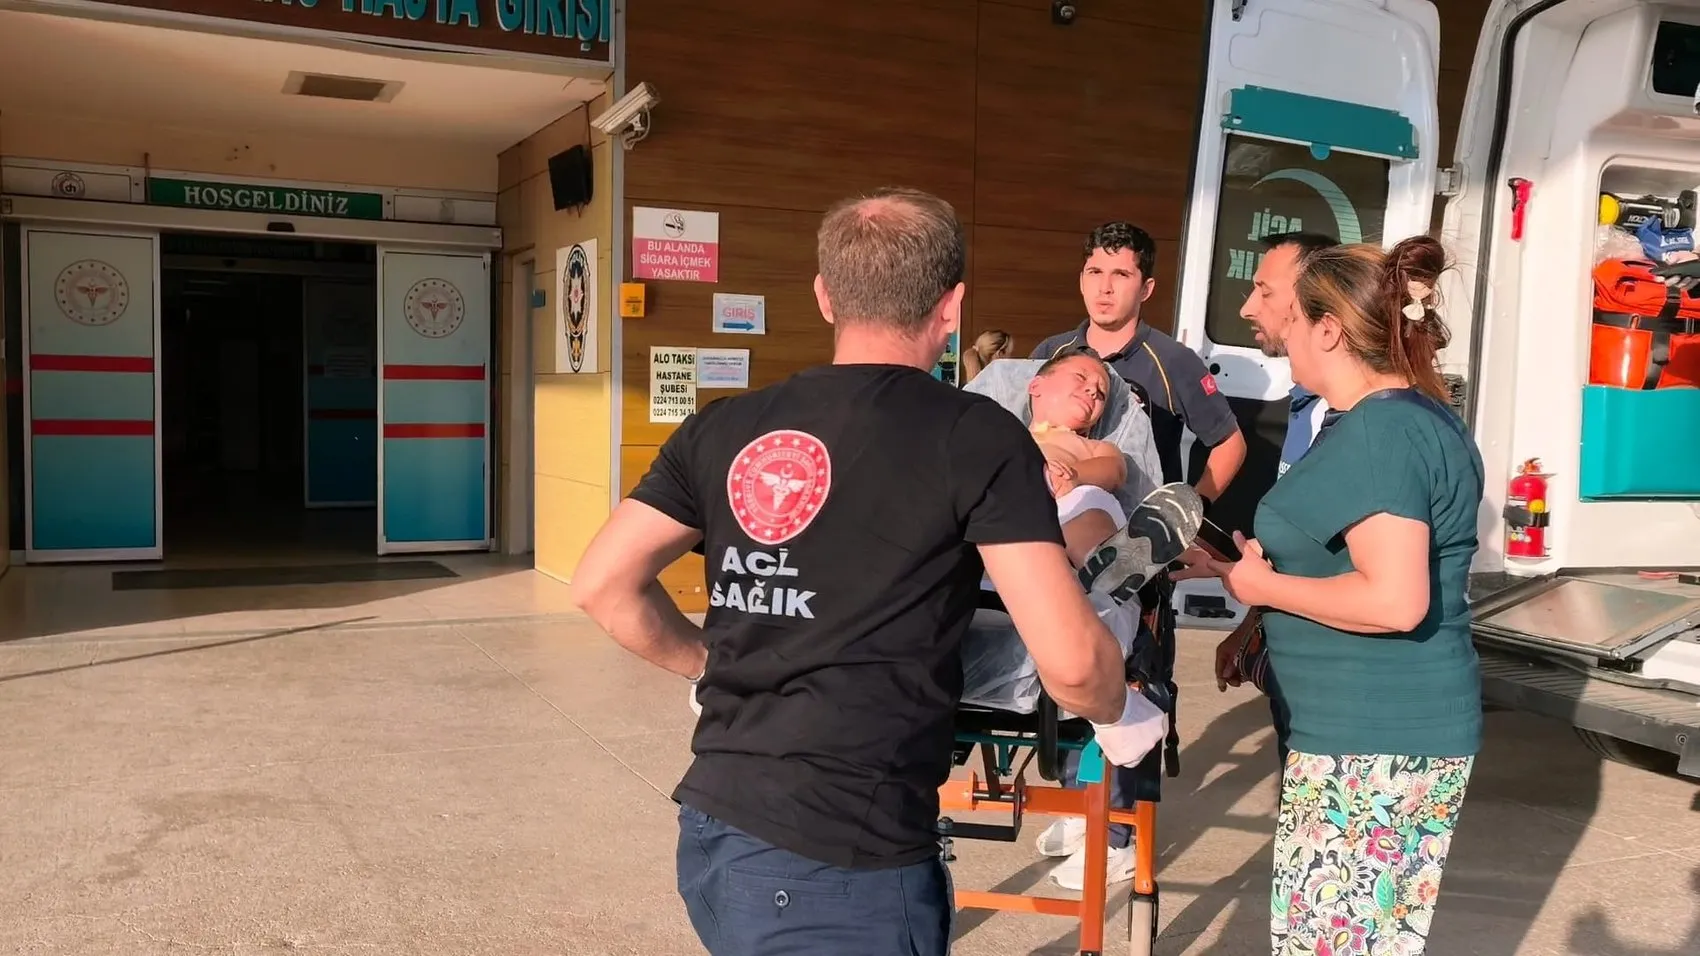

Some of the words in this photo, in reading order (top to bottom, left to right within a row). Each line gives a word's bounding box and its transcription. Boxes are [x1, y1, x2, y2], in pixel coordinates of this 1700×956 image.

[184, 185, 348, 215] HOŞGELDİNİZ
[648, 240, 662, 251] BU
[664, 242, 705, 254] ALANDA
[640, 252, 678, 266] SİGARA
[680, 256, 712, 268] İÇMEK
[652, 267, 700, 280] YASAKTIR
[654, 353, 670, 364] ALO
[656, 371, 692, 380] HASTANE
[653, 396, 667, 405] 0224
[668, 396, 678, 405] 713
[688, 397, 694, 405] 51
[653, 408, 667, 417] 0224
